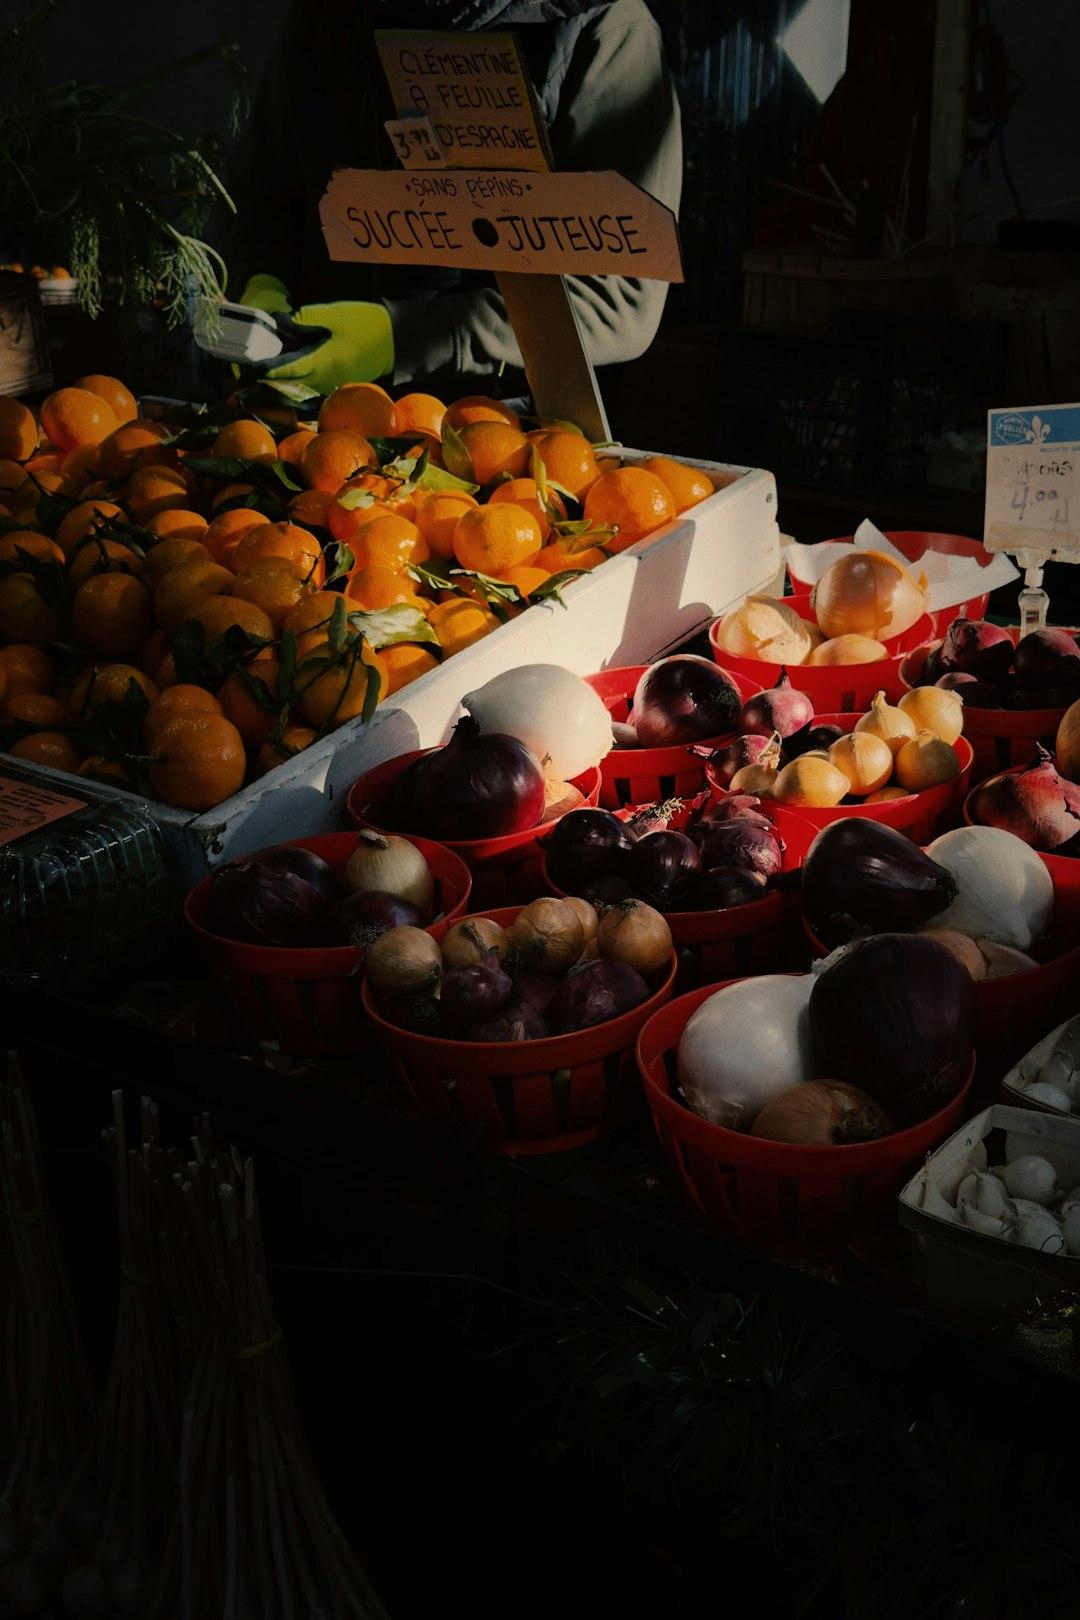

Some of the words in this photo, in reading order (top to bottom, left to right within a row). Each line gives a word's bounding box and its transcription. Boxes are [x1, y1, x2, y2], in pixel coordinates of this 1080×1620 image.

[400, 47, 519, 75] CLÉMENTINE
[406, 79, 430, 110] À
[437, 79, 523, 109] FEUILLE
[436, 125, 537, 149] D'ESPAGNE
[411, 178, 458, 197] SANS
[466, 176, 524, 198] PÉPINS
[496, 214, 648, 254] JUTEUSE
